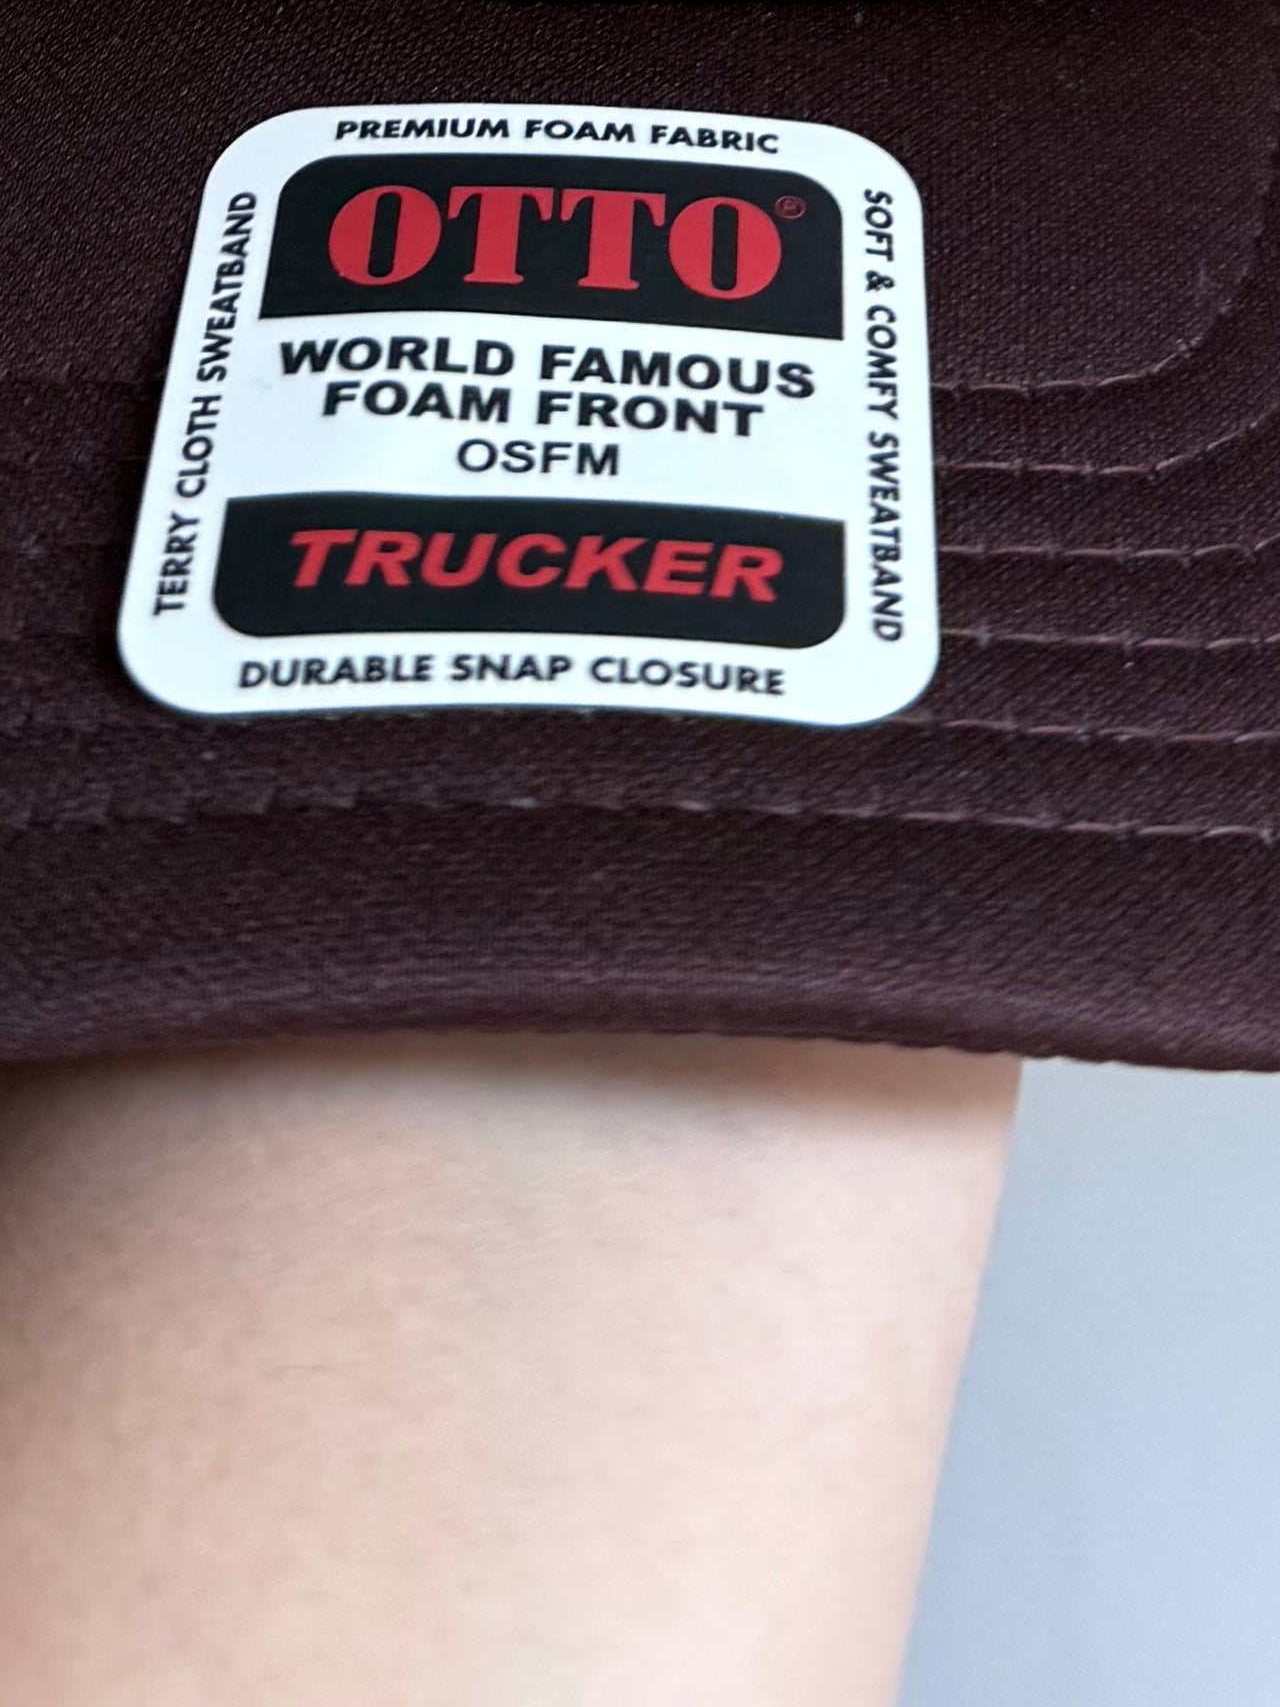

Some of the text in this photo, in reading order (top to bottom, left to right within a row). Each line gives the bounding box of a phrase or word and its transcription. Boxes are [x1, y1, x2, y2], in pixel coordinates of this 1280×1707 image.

[335, 117, 780, 155] PREMIUM FOAM FABRIC
[279, 336, 817, 400] WORLD FAMOUS
[152, 190, 258, 617] TERRY CLOTH SWEATBAND
[322, 379, 766, 437] FOAM FRONT
[863, 187, 905, 643] SOFT & COMFY SWEATBAND
[456, 437, 621, 477] OSFM
[289, 528, 785, 604] TRUCKER
[237, 653, 787, 696] DURABLE SNAP CLOSURE
